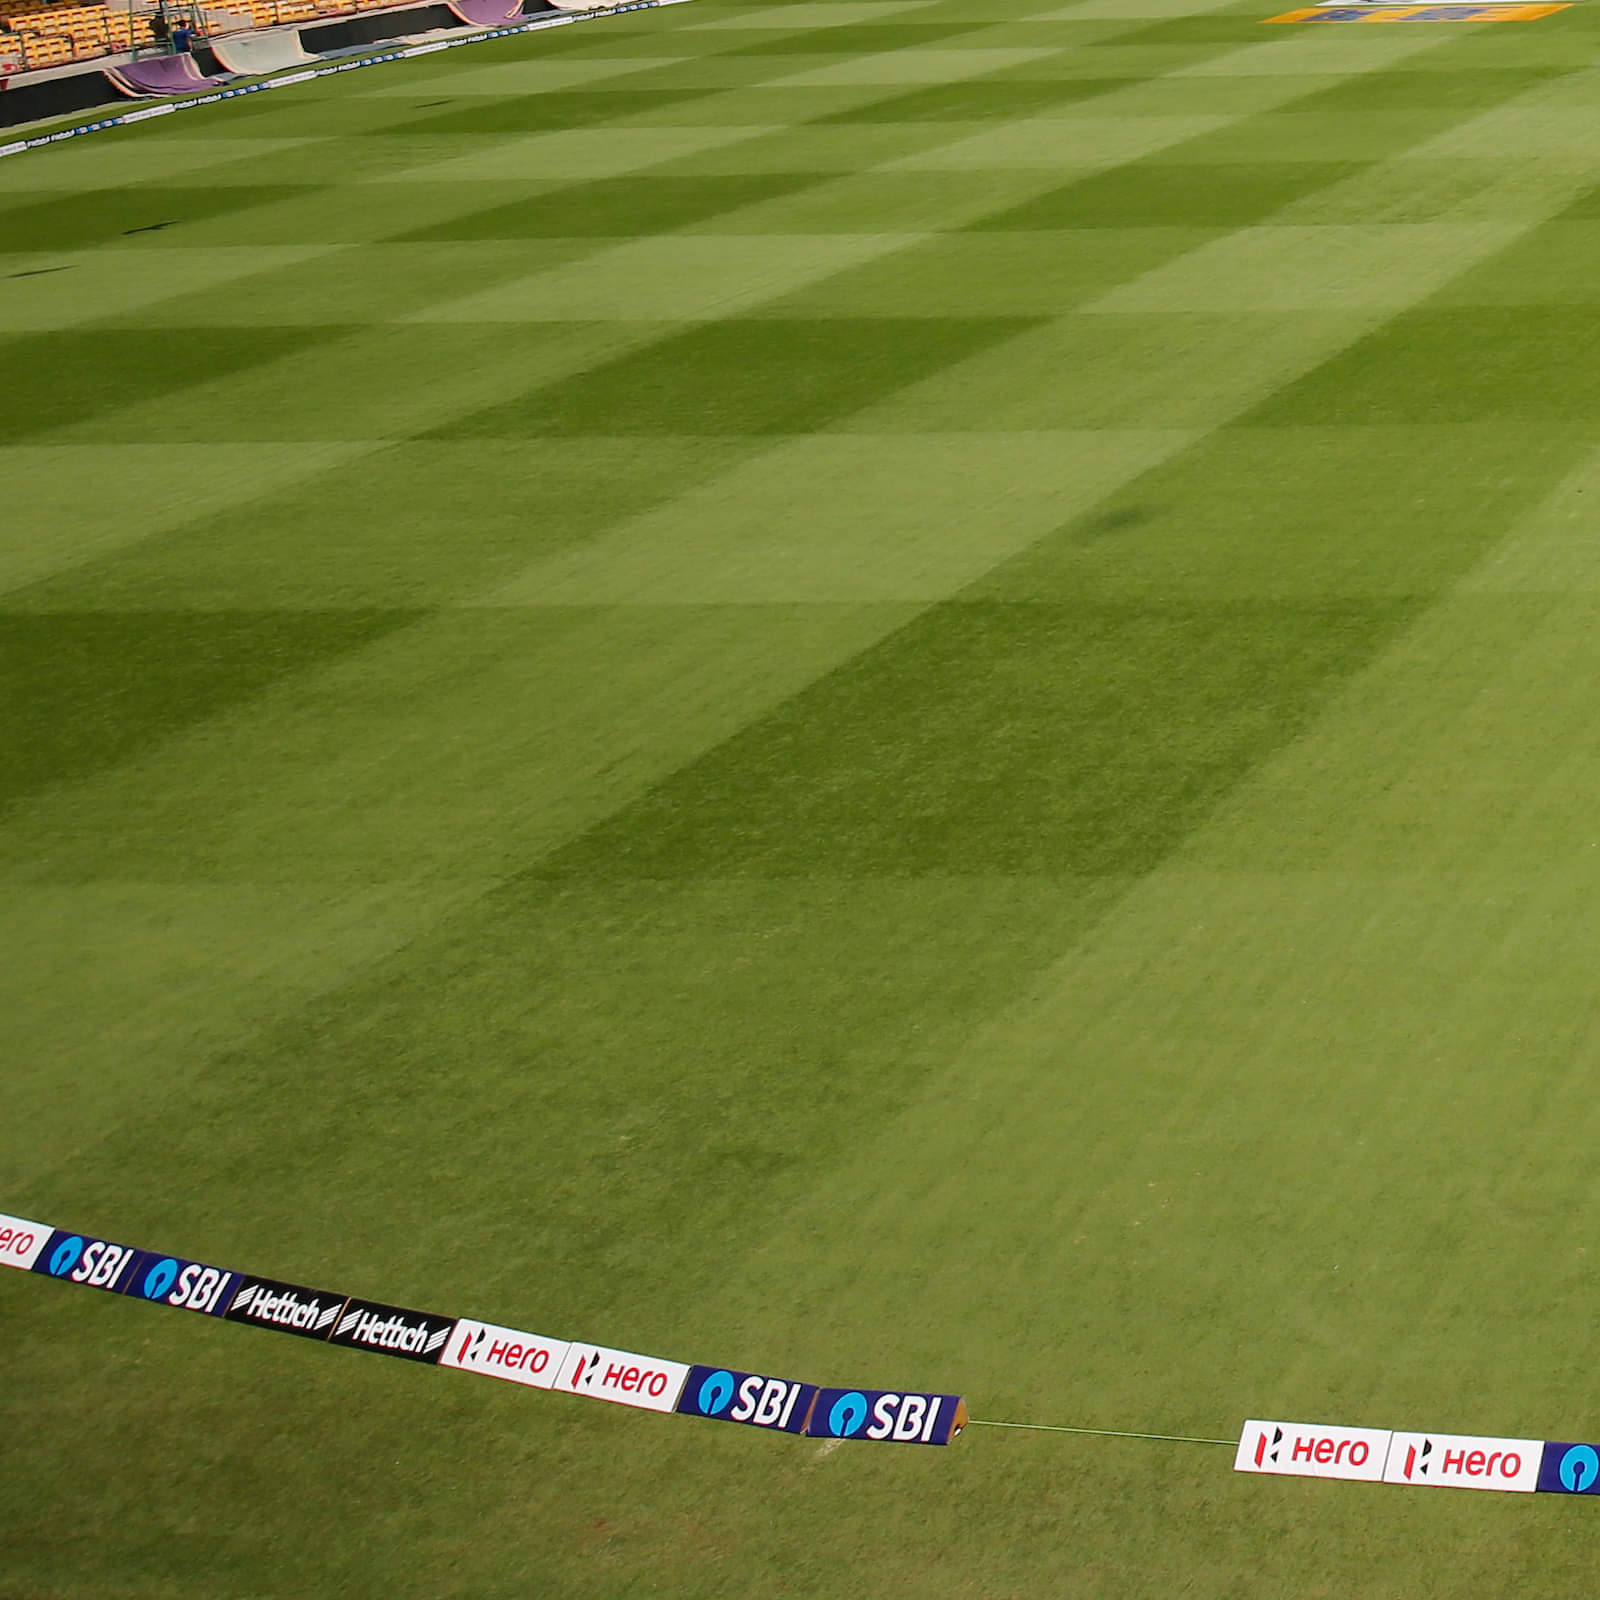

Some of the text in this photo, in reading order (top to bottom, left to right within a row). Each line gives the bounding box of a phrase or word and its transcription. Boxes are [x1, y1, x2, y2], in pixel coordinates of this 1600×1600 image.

[71, 1240, 135, 1289] SBI
[168, 1263, 232, 1314] SBI
[246, 1290, 321, 1331] Hettich
[352, 1312, 428, 1354] Hettich
[485, 1338, 551, 1374] Hero
[602, 1361, 670, 1397] Hero
[730, 1376, 803, 1428] SBI
[866, 1393, 943, 1442] SBI
[1291, 1435, 1371, 1468] Hero
[1441, 1446, 1523, 1480] Hero
